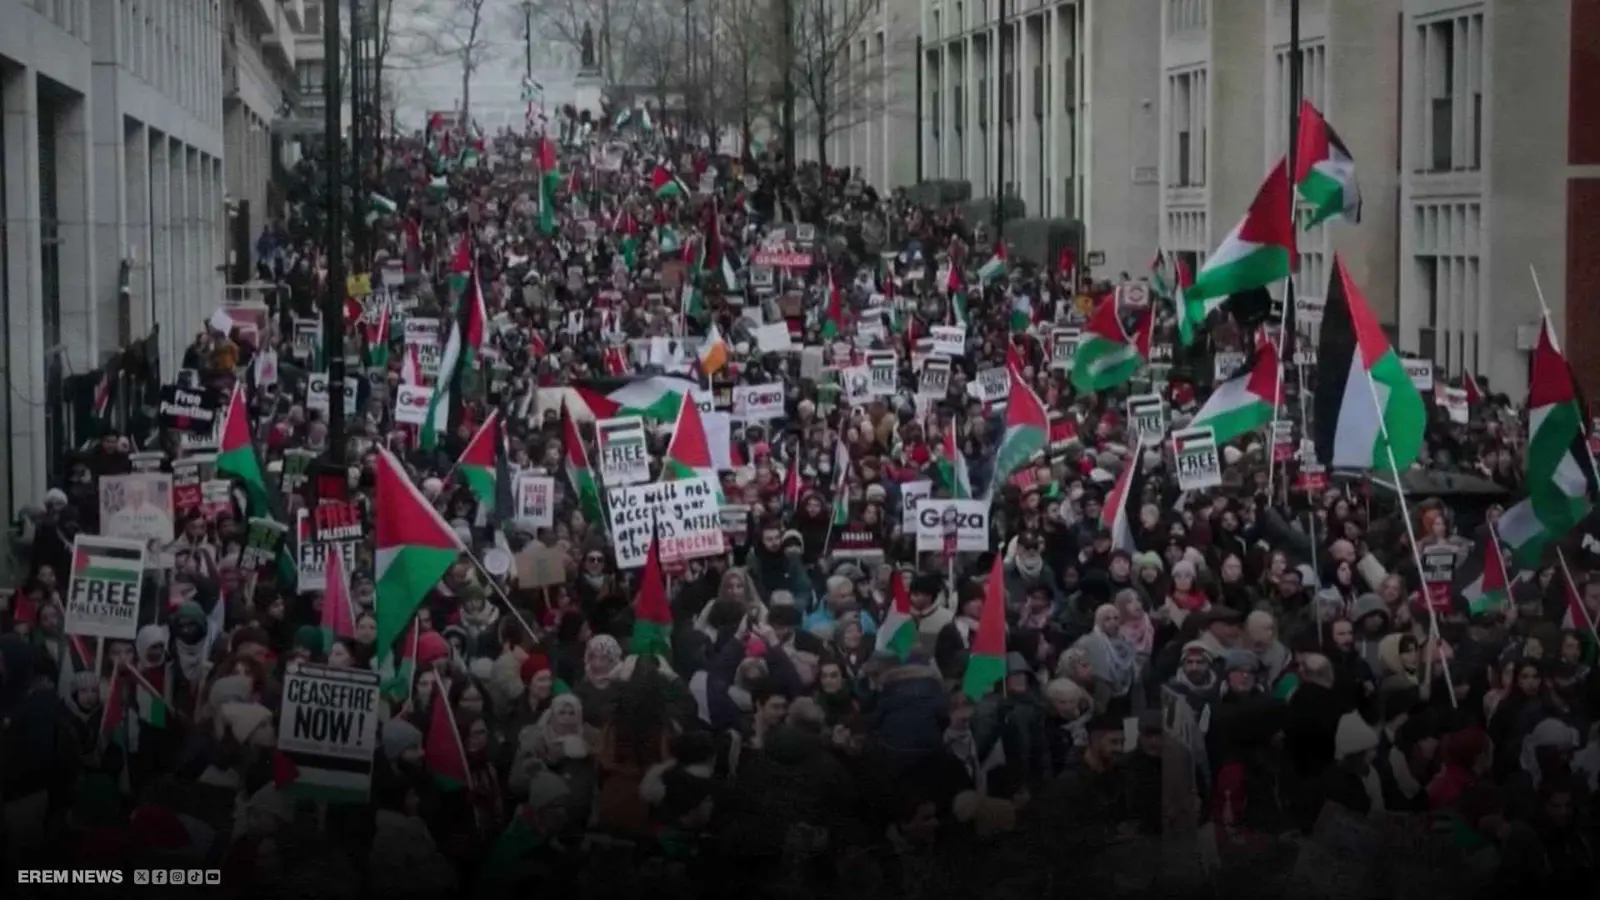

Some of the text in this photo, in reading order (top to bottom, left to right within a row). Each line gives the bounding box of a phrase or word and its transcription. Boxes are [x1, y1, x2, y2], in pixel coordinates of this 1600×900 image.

[602, 445, 645, 464] FREE
[1179, 453, 1214, 470] FREE
[609, 481, 710, 509] We will not
[673, 500, 704, 520] your
[919, 506, 985, 530] Gaza
[300, 543, 353, 564] FRE
[71, 578, 137, 605] FREE
[69, 601, 133, 618] PALESTINE
[287, 678, 374, 713] CEASEFIRE
[294, 704, 365, 747] NOW!
